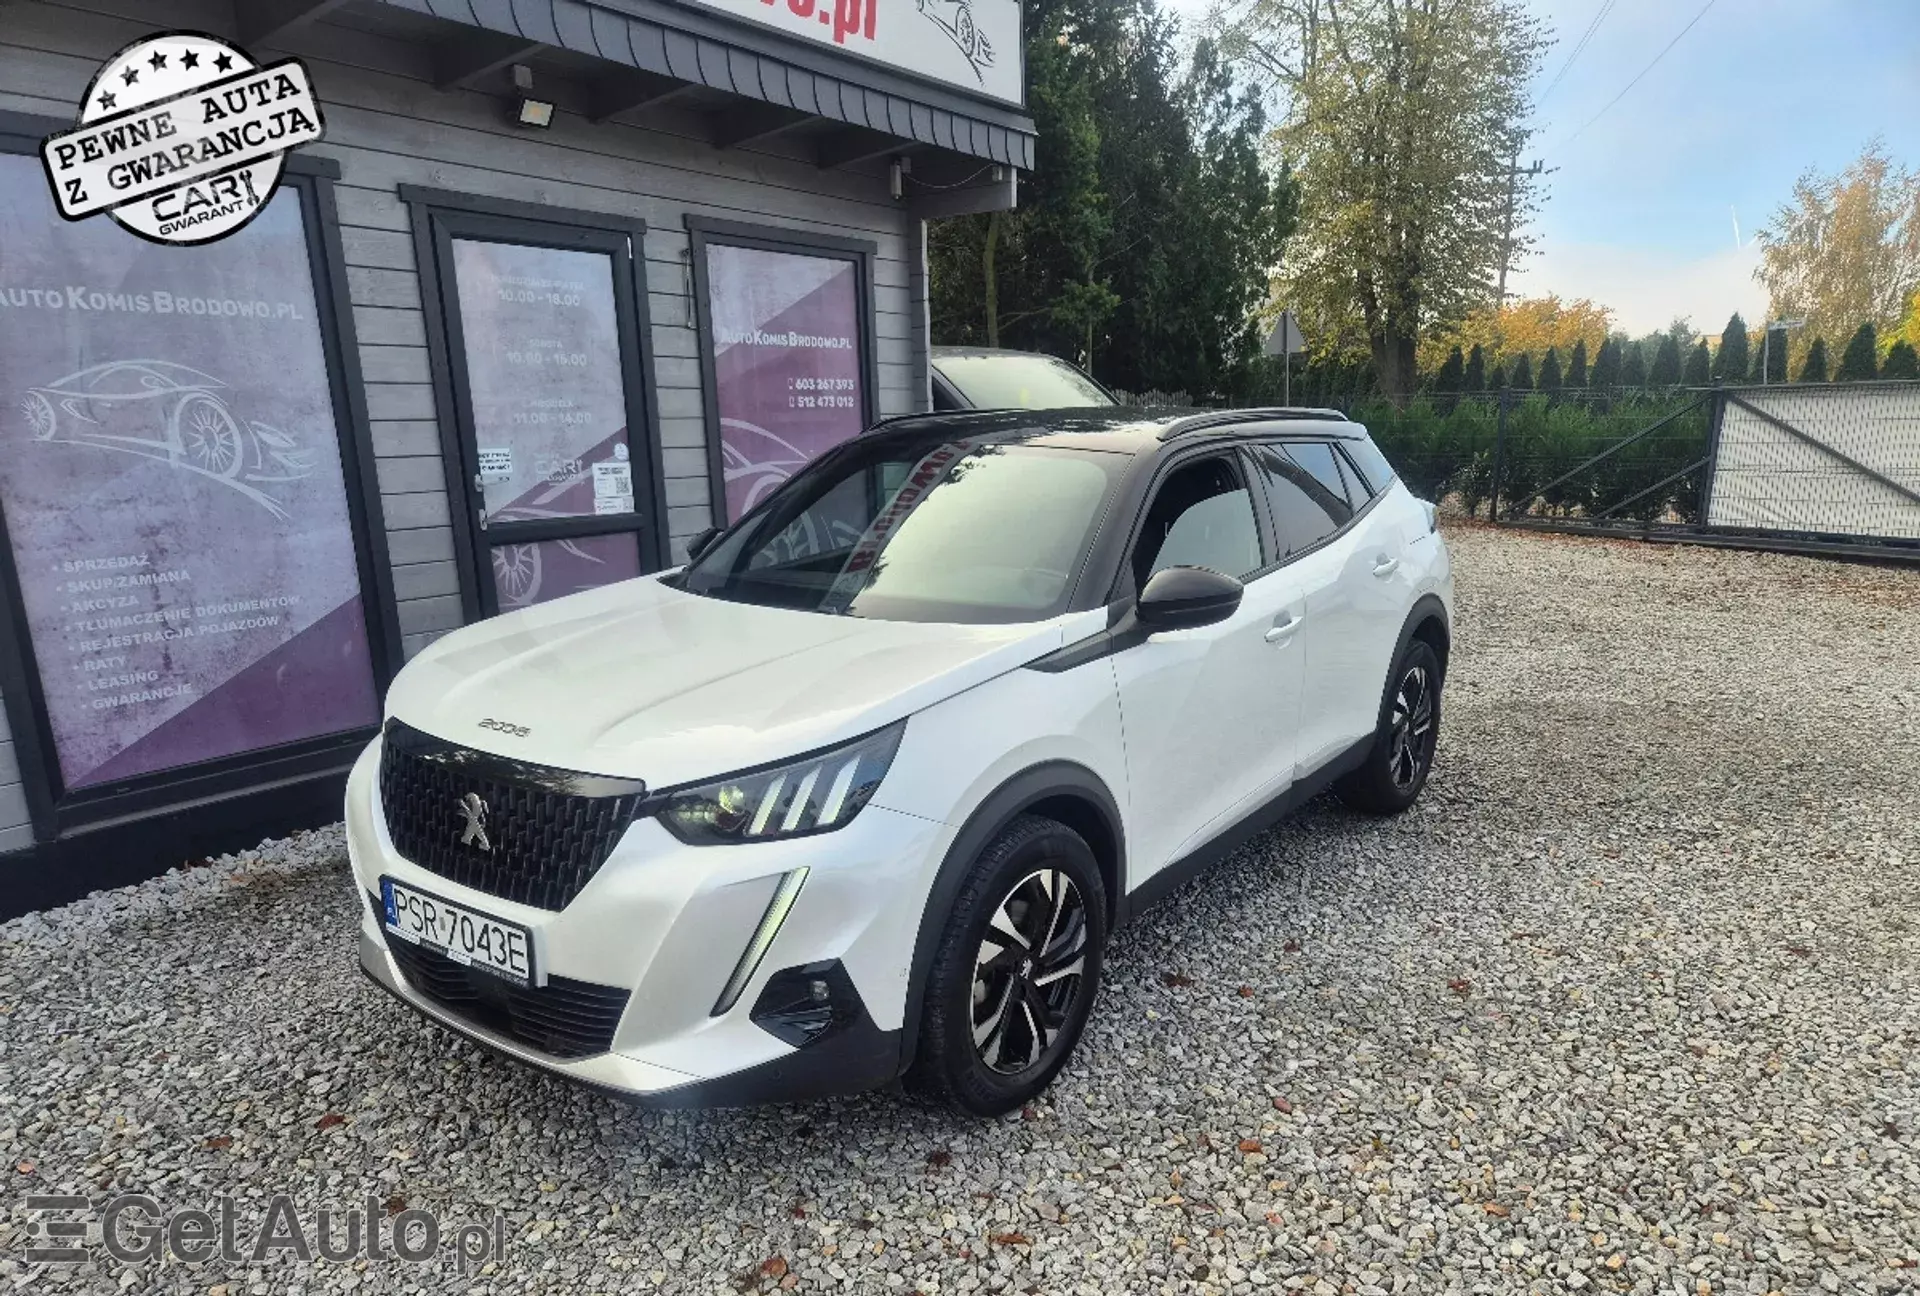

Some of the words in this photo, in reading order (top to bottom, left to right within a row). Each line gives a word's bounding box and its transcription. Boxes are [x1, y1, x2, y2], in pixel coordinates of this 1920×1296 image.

[64, 552, 150, 573] SPRZEDAŻ
[72, 595, 140, 613] AKCYZA
[80, 626, 195, 653] REJESTRACJA
[88, 670, 159, 691] LEASING
[93, 682, 193, 709] GWARANCJE
[393, 888, 439, 941] PSR
[445, 908, 527, 975] 7043E
